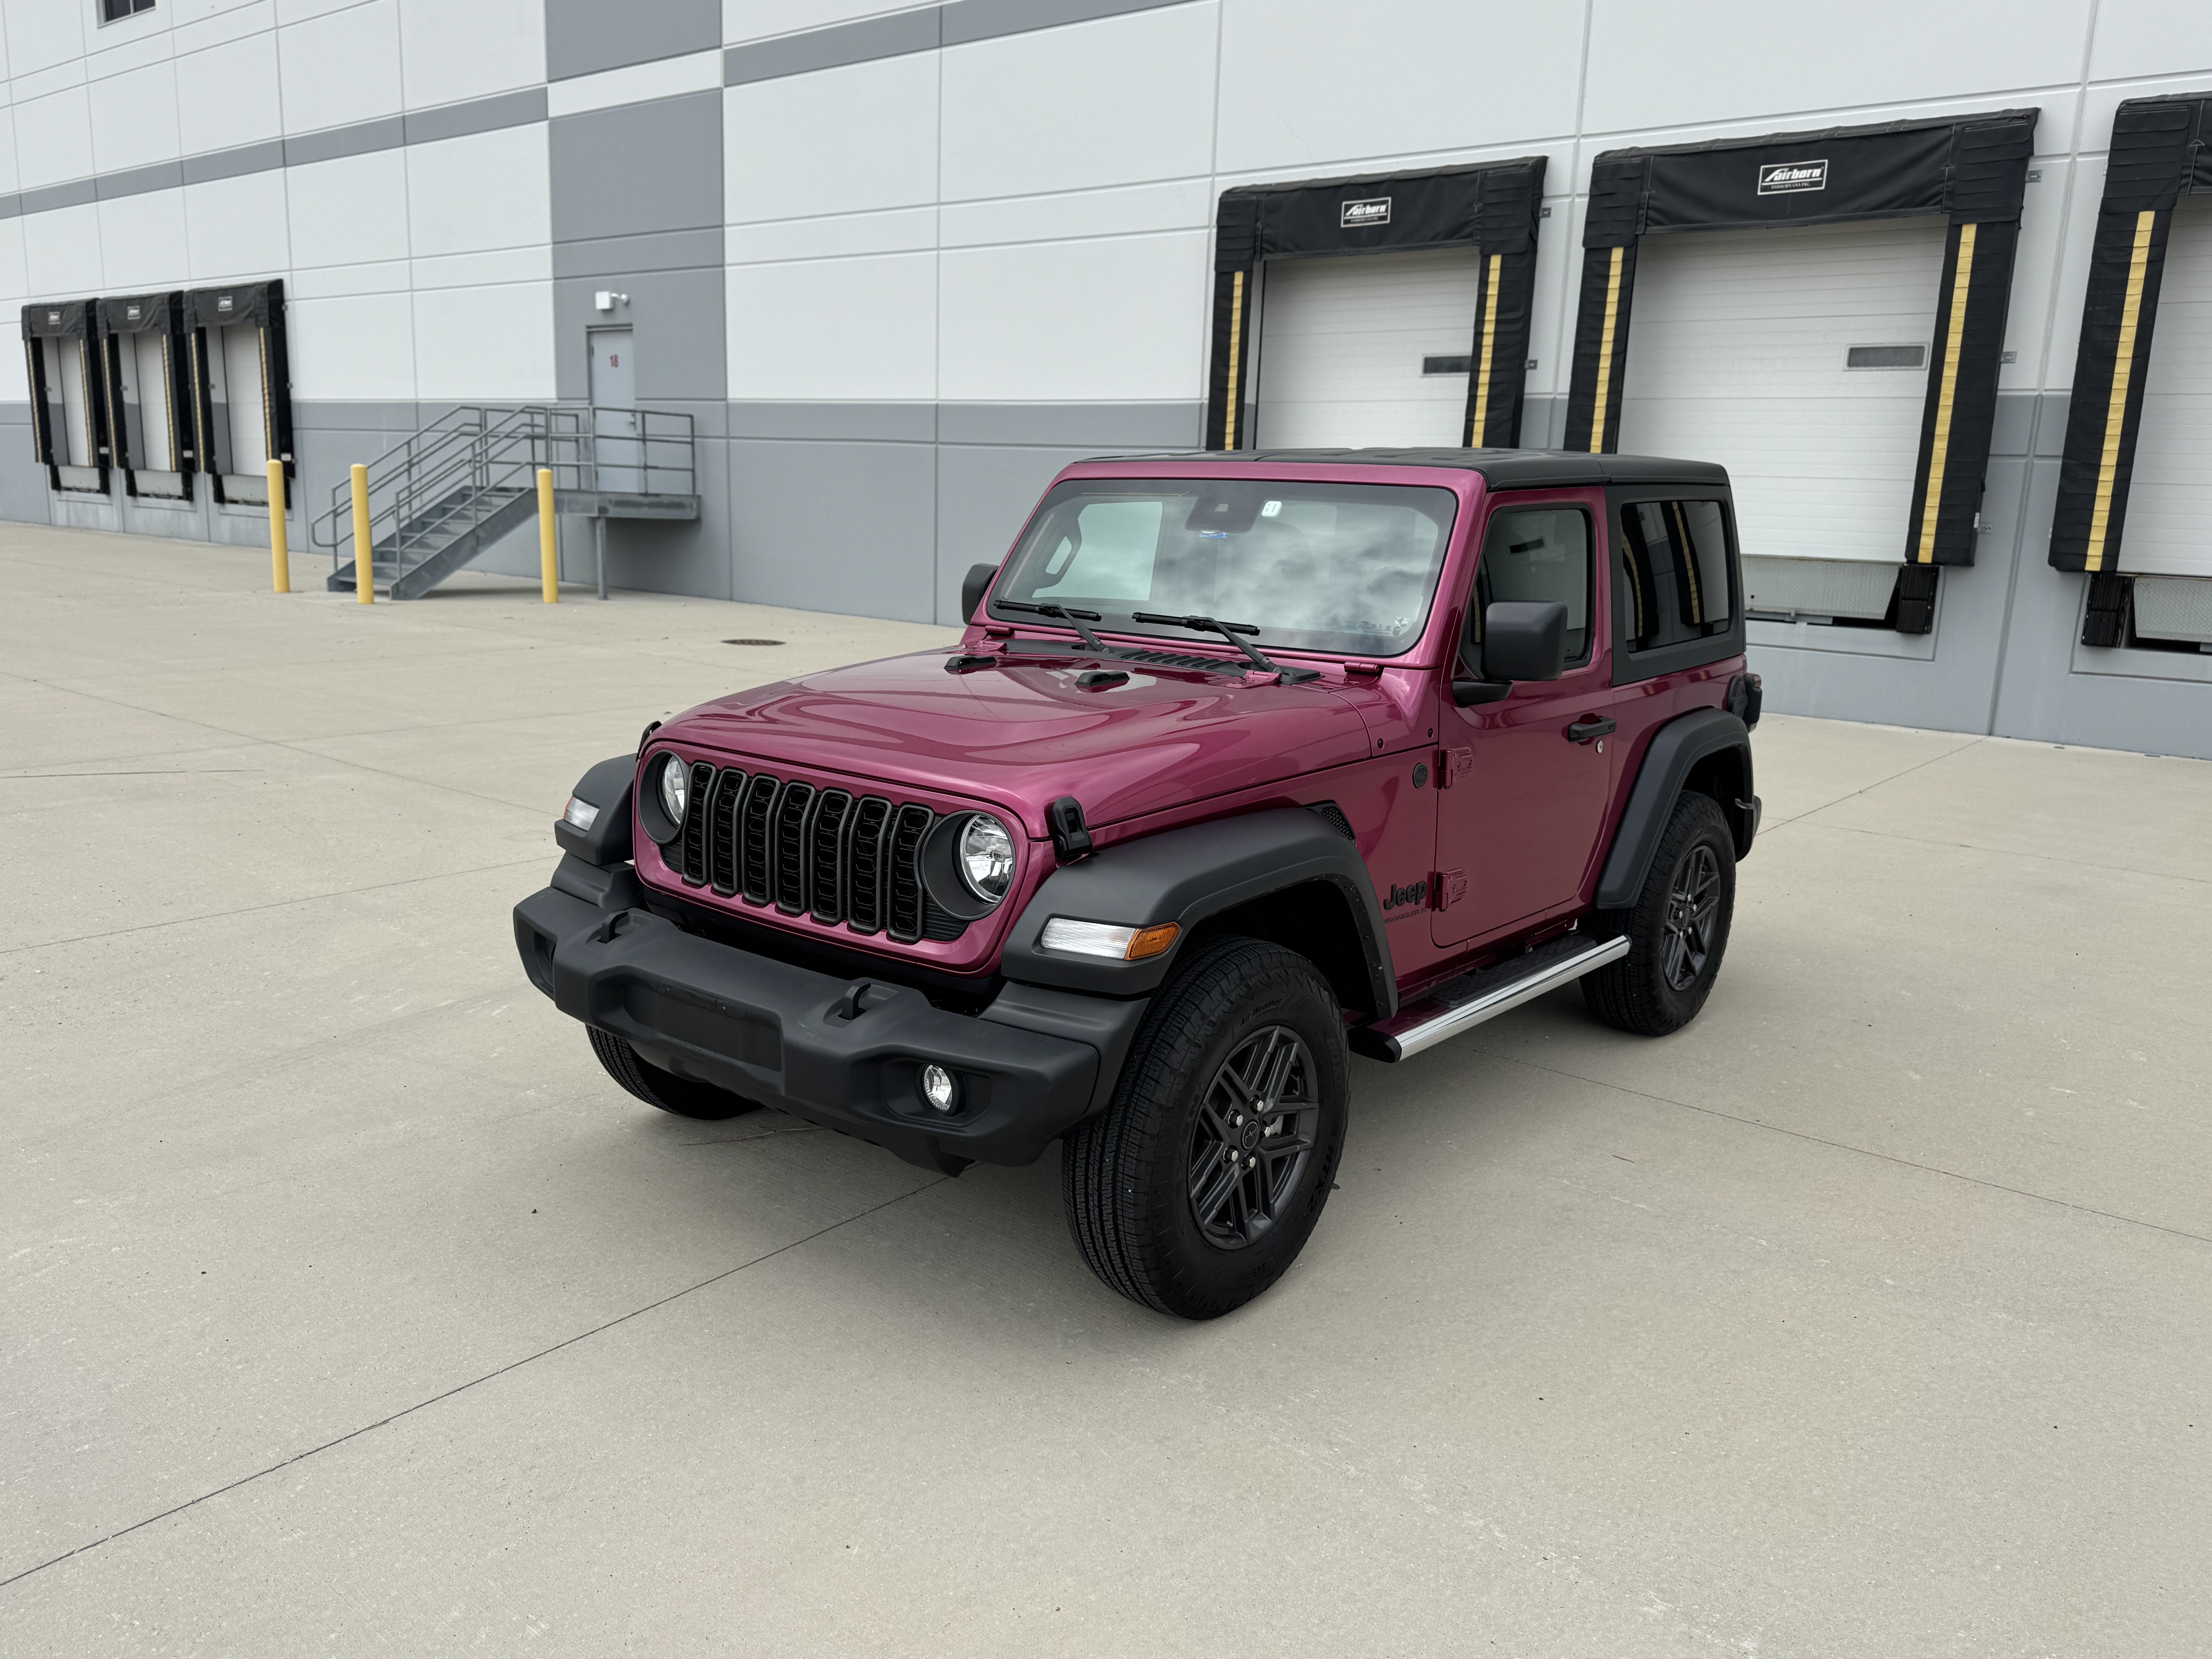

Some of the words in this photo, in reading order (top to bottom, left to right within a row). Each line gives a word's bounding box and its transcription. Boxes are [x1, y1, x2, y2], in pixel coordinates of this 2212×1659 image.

[1764, 168, 1822, 182] Fairborn
[1345, 203, 1387, 216] Fairborn
[1383, 881, 1427, 910] Jeep
[1240, 999, 1282, 1027] All-Weather
